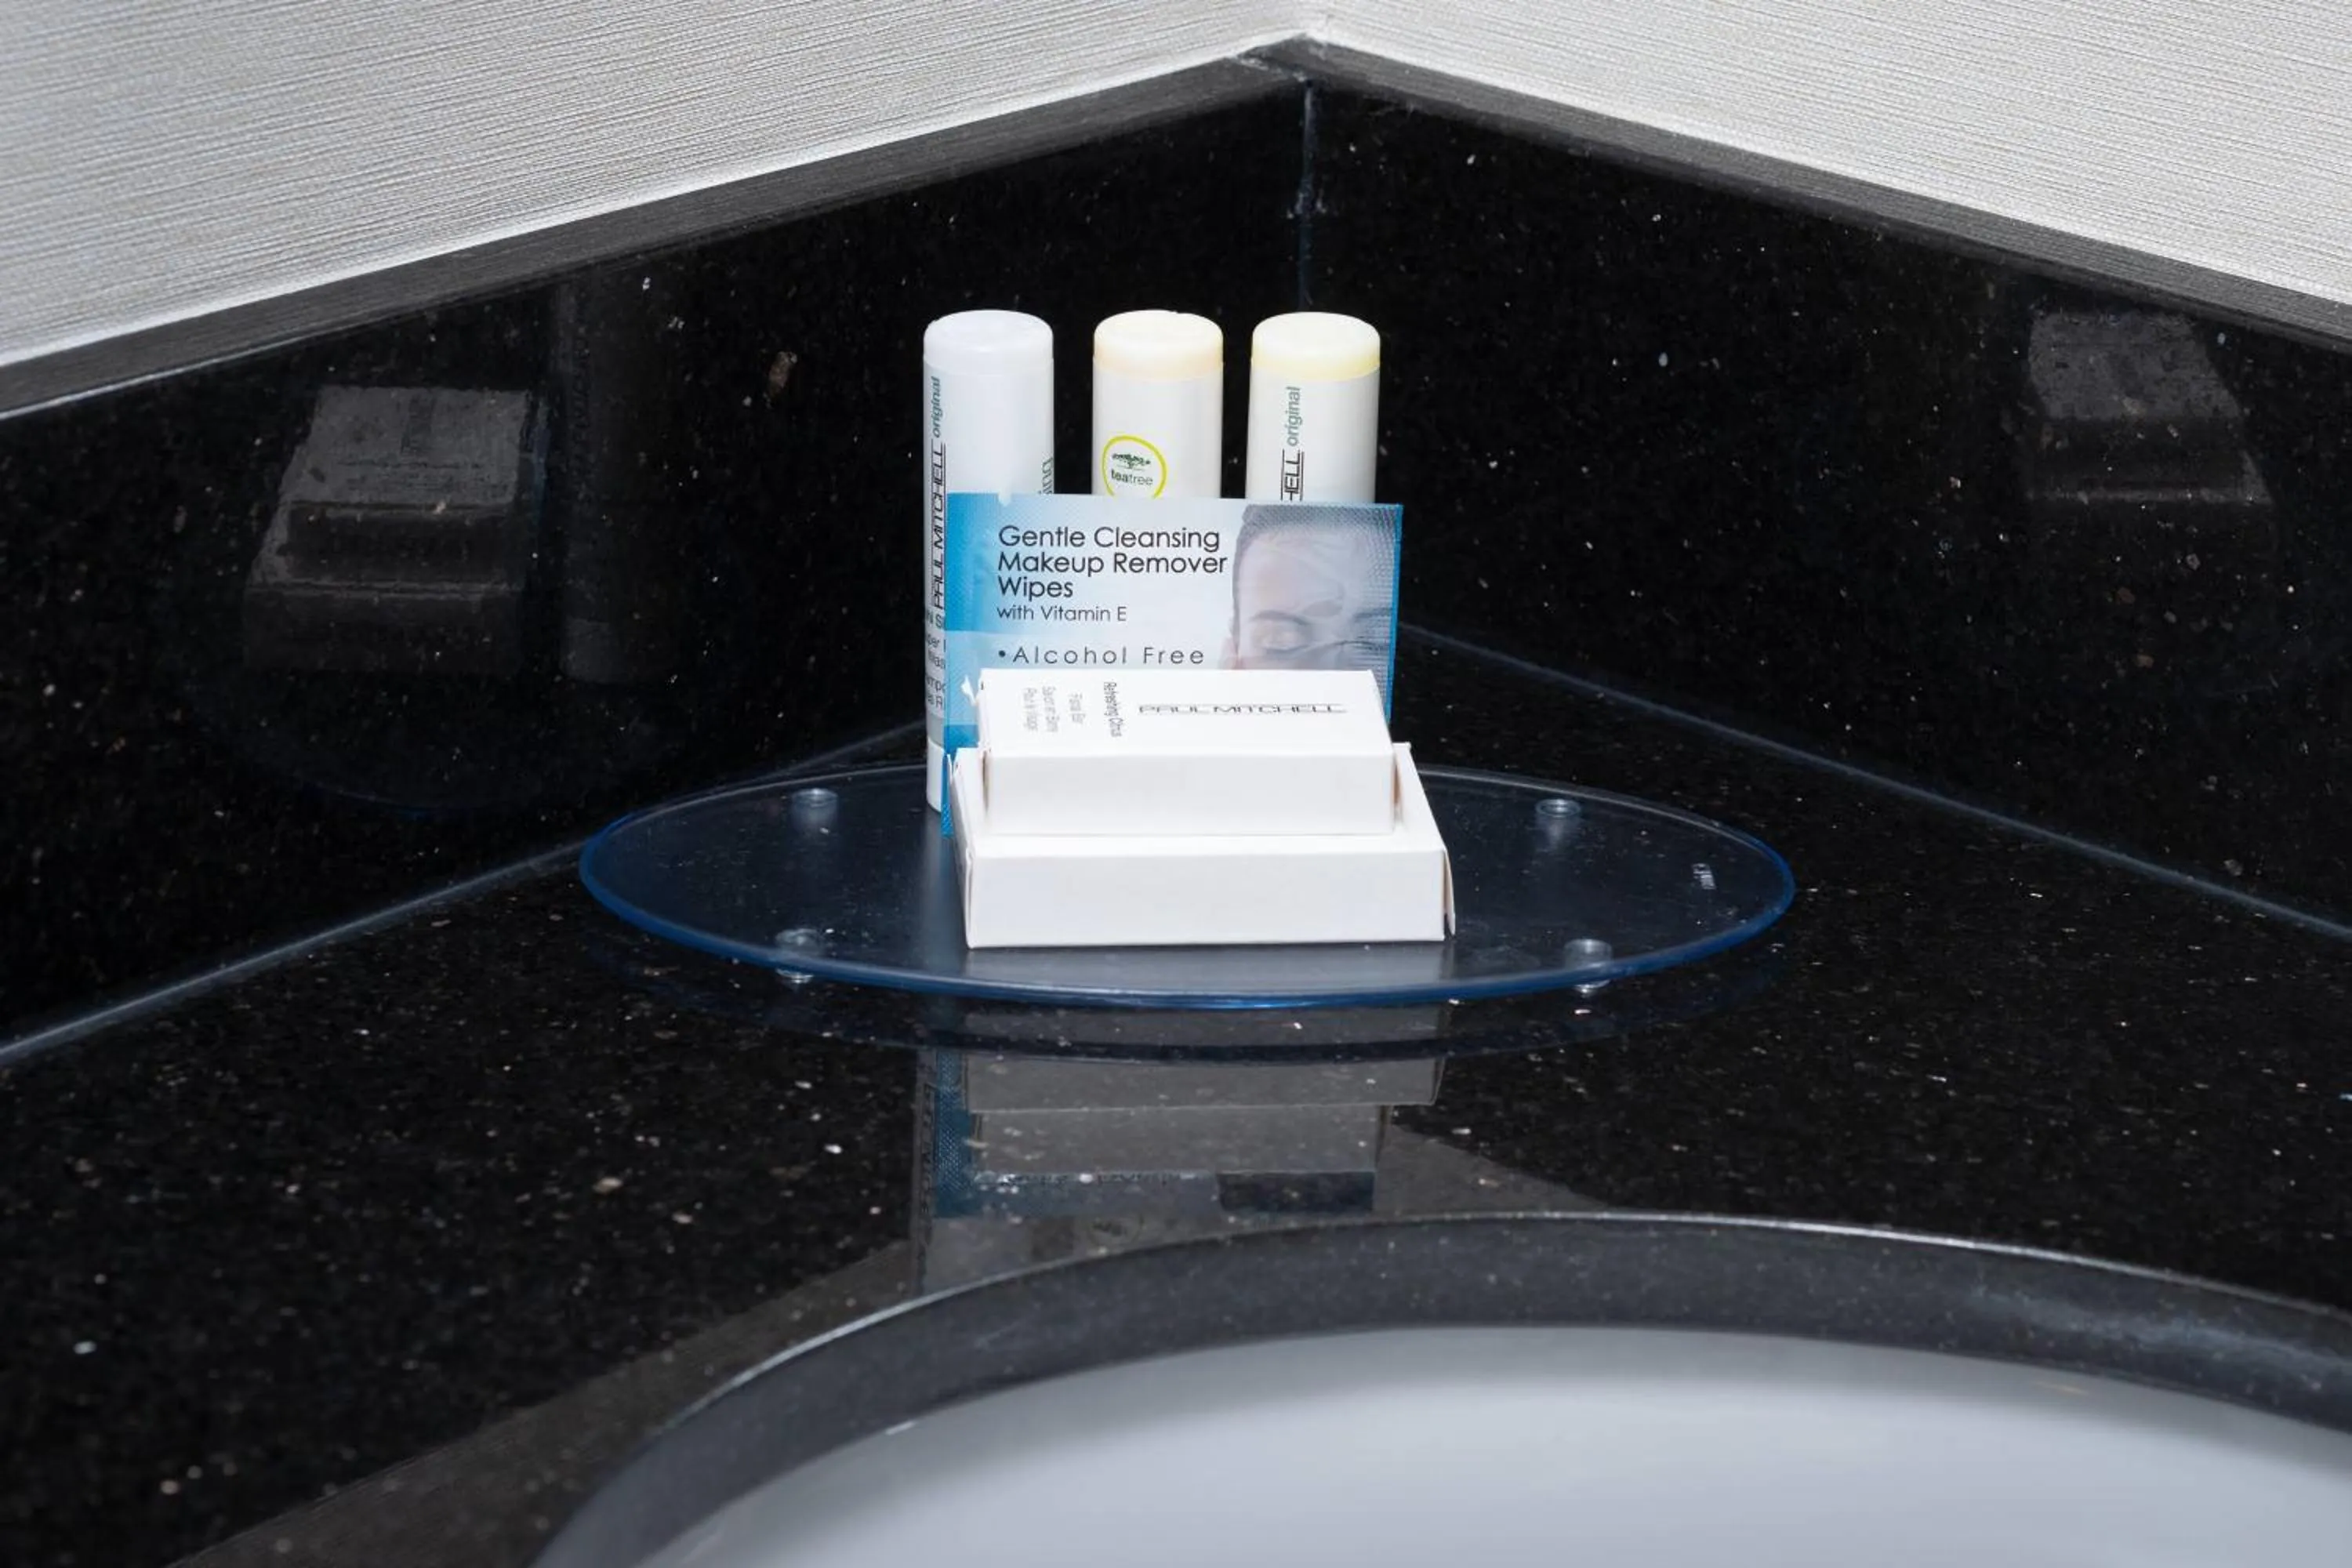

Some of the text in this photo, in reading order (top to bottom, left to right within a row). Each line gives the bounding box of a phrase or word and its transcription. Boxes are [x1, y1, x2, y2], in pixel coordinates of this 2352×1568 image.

[931, 376, 943, 439] original
[1285, 386, 1303, 447] original
[998, 524, 1221, 553] Gentle Cleansing
[997, 551, 1229, 578] Makeup Remover
[997, 576, 1074, 602] Wipes
[996, 604, 1127, 622] with Vitamin E
[1012, 646, 1205, 665] Alcohol Free
